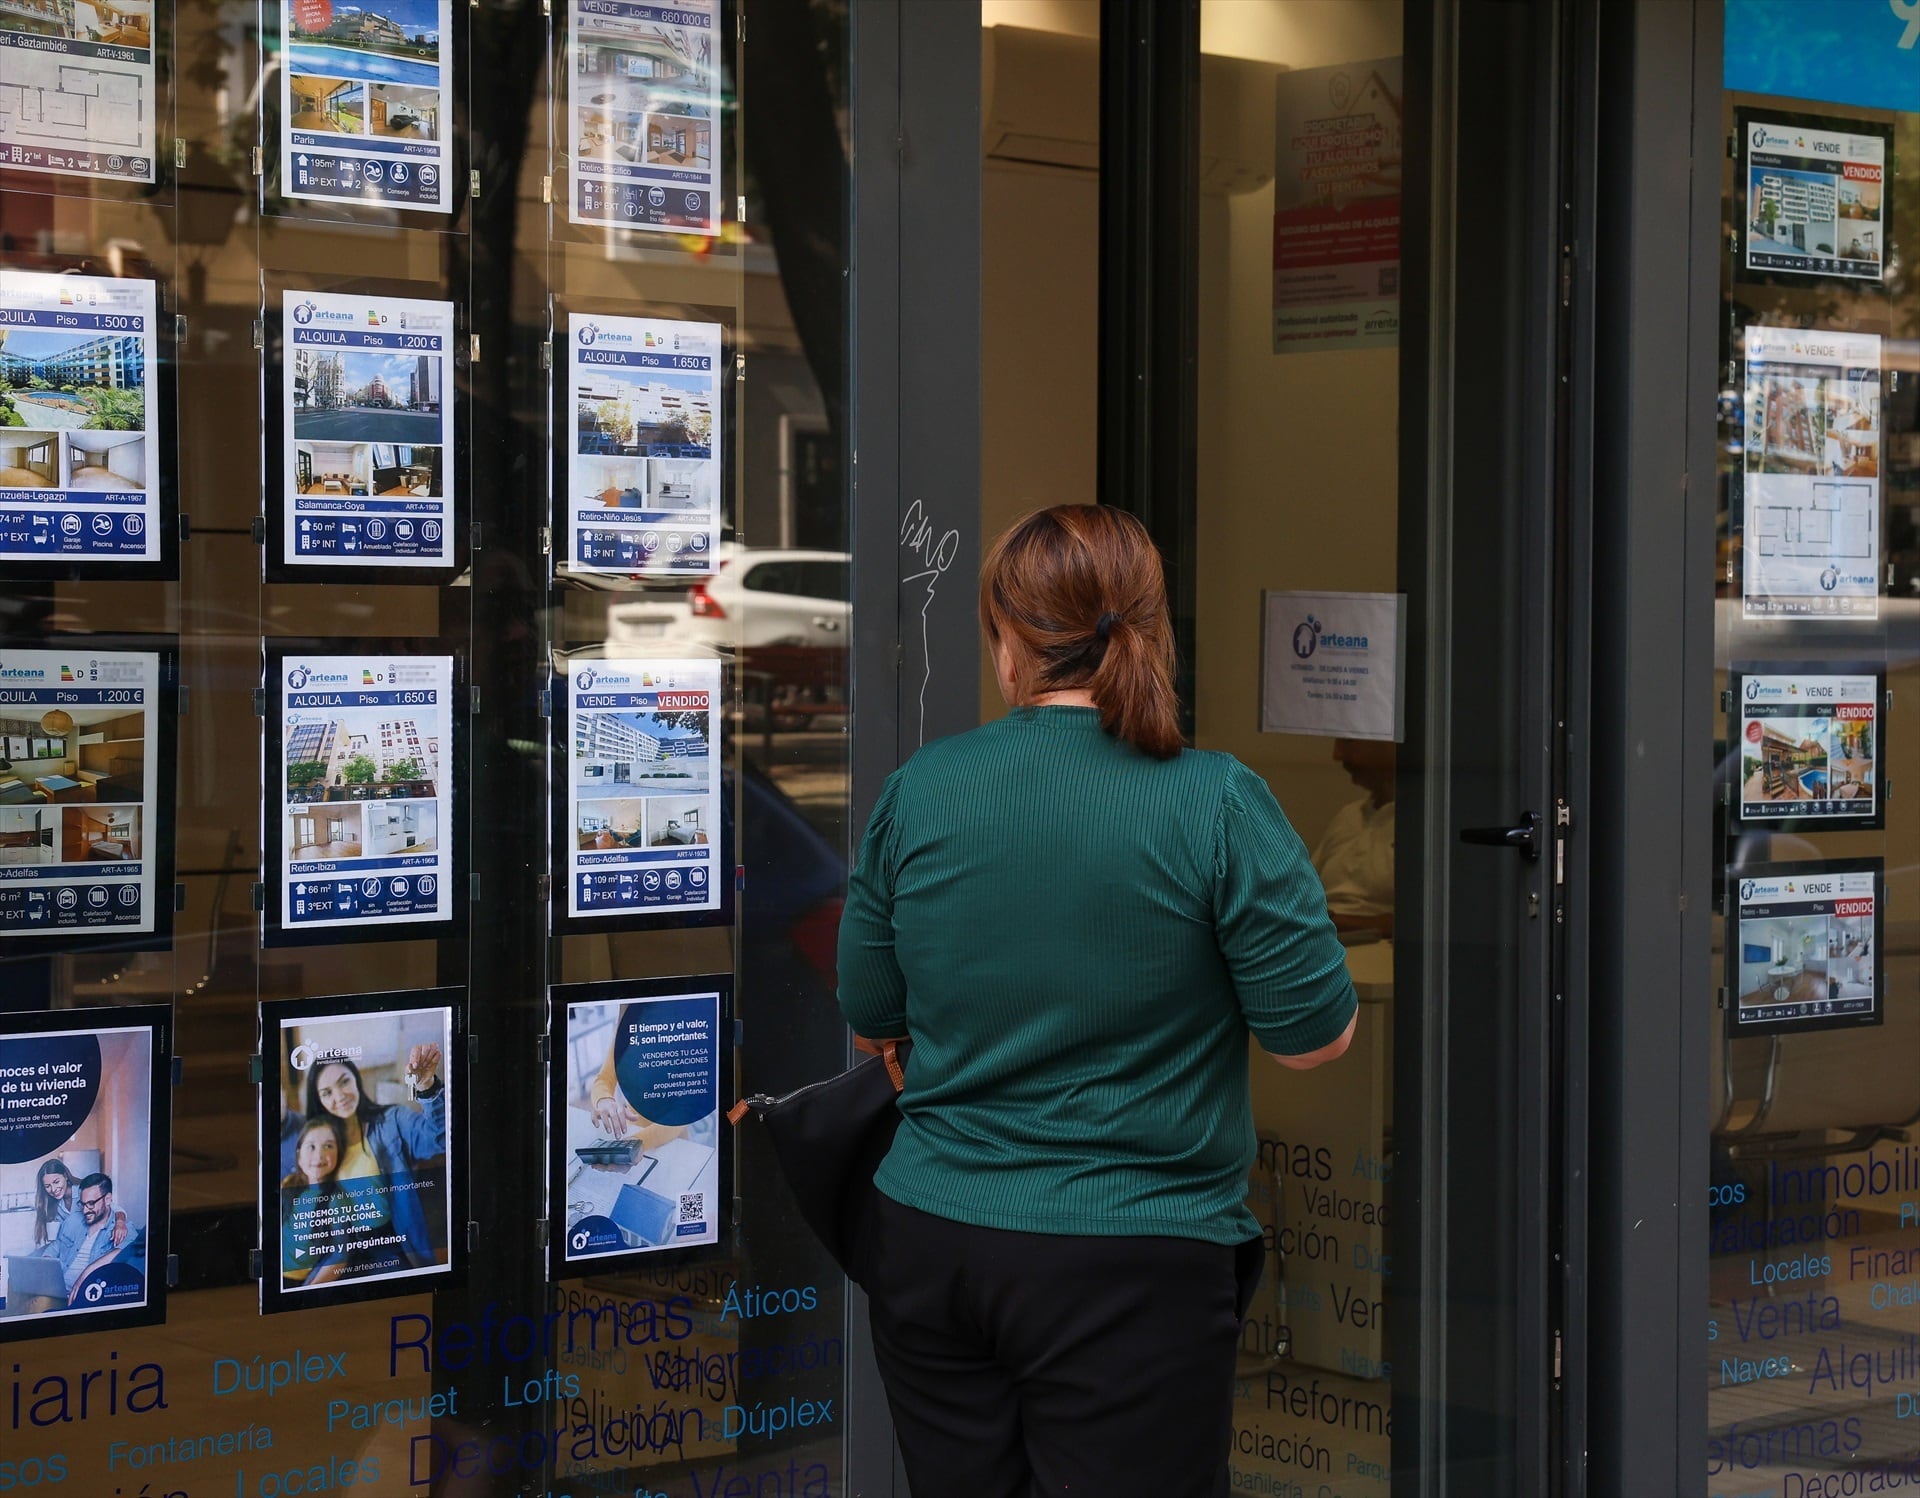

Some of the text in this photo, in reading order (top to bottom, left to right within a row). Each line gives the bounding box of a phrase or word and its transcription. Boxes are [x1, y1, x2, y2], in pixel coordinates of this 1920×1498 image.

[583, 0, 618, 15] VENDE
[629, 7, 652, 18] Local
[661, 11, 701, 26] 660.000
[17, 36, 136, 62] Gaztambide ART-V-1961
[293, 135, 315, 145] Parla
[1812, 141, 1841, 154] VENDE
[1843, 165, 1882, 181] VENDIDO
[320, 177, 337, 188] EXT
[0, 310, 142, 329] QUILA Piso 1.500 €
[315, 310, 354, 320] arteana
[1365, 317, 1398, 330] arrenta
[299, 331, 438, 349] ALQUILA Piso 1.200 €
[598, 332, 633, 342] arteana
[1804, 344, 1836, 357] VENDE
[584, 352, 709, 369] ALQUILA Piso 1.650 €
[298, 500, 365, 512] Salamanca-Goya
[580, 512, 642, 522] Retiro-Niño Jesús
[11, 533, 30, 542] EXT
[92, 540, 113, 548] Piscina
[322, 539, 337, 548] INT
[1839, 575, 1874, 585] arteana
[1320, 633, 1368, 648] arteana
[1, 668, 45, 678] arteana
[309, 672, 349, 682] arteana
[595, 675, 630, 684] arteana
[0, 690, 142, 702] QUILA Piso 1.200 €
[294, 691, 435, 706] ALQUILA Piso 1.650 €
[1805, 687, 1833, 697] VENDE
[582, 694, 709, 708] VENDE Piso VENDIDO
[1836, 706, 1874, 719] VENDIDO
[579, 854, 629, 864] Retiro-Adelfas
[291, 863, 336, 873] Retiro-Ibiza
[601, 890, 617, 900] EXT
[1754, 885, 1779, 895] arteana
[1803, 883, 1832, 895] VENDE
[6, 909, 25, 919] EXT
[1835, 901, 1874, 914] VENDIDO
[629, 1019, 709, 1034] El tiempo y el valor,
[641, 1036, 656, 1044] son
[657, 1031, 709, 1045] importantes.
[316, 1046, 362, 1058] arteana
[642, 1050, 679, 1060] VENDEMOS
[690, 1048, 709, 1056] CASA
[0, 1061, 82, 1078] noces el valor
[638, 1057, 709, 1069] SIN COMPLICACIONES
[667, 1071, 696, 1079] Tenemos
[1, 1077, 87, 1093] de tu vivienda
[653, 1081, 686, 1089] propuesta
[643, 1091, 661, 1099] Entra
[667, 1088, 709, 1098] pregúntanos.
[7, 1094, 69, 1110] mercado?
[25, 1120, 73, 1129] complicaciones
[1258, 1139, 1332, 1182] mas
[302, 1195, 329, 1205] tiempo
[337, 1191, 344, 1200] el
[345, 1190, 364, 1199] valor
[375, 1186, 389, 1195] son
[389, 1180, 436, 1193] importantes.
[1708, 1183, 1746, 1207] cos
[293, 1203, 376, 1221] VENDEMOS TU CASA
[293, 1211, 384, 1230] SIN COMPLICACIONES.
[293, 1224, 372, 1242] Tenemos una oferta.
[588, 1232, 617, 1241] arteana
[309, 1234, 407, 1256] Entra y pregúntanos
[333, 1258, 400, 1275] www.arteana.com
[1751, 1252, 1832, 1285] Locales
[104, 1283, 139, 1294] arteana
[720, 1281, 817, 1322] Áticos
[1731, 1290, 1842, 1344] Venta
[389, 1295, 695, 1378] Reformas
[1707, 1320, 1719, 1341] s
[213, 1350, 347, 1397] Dúplex
[1721, 1356, 1792, 1386] Naves
[12, 1351, 169, 1430] iaria
[503, 1369, 581, 1408] Lofts
[328, 1386, 458, 1432] Parquet
[723, 1396, 834, 1440] Dúplex
[108, 1424, 273, 1473] Fontanería
[409, 1400, 704, 1487] Decoración
[0, 1453, 68, 1491] sos
[236, 1455, 381, 1498] Locales
